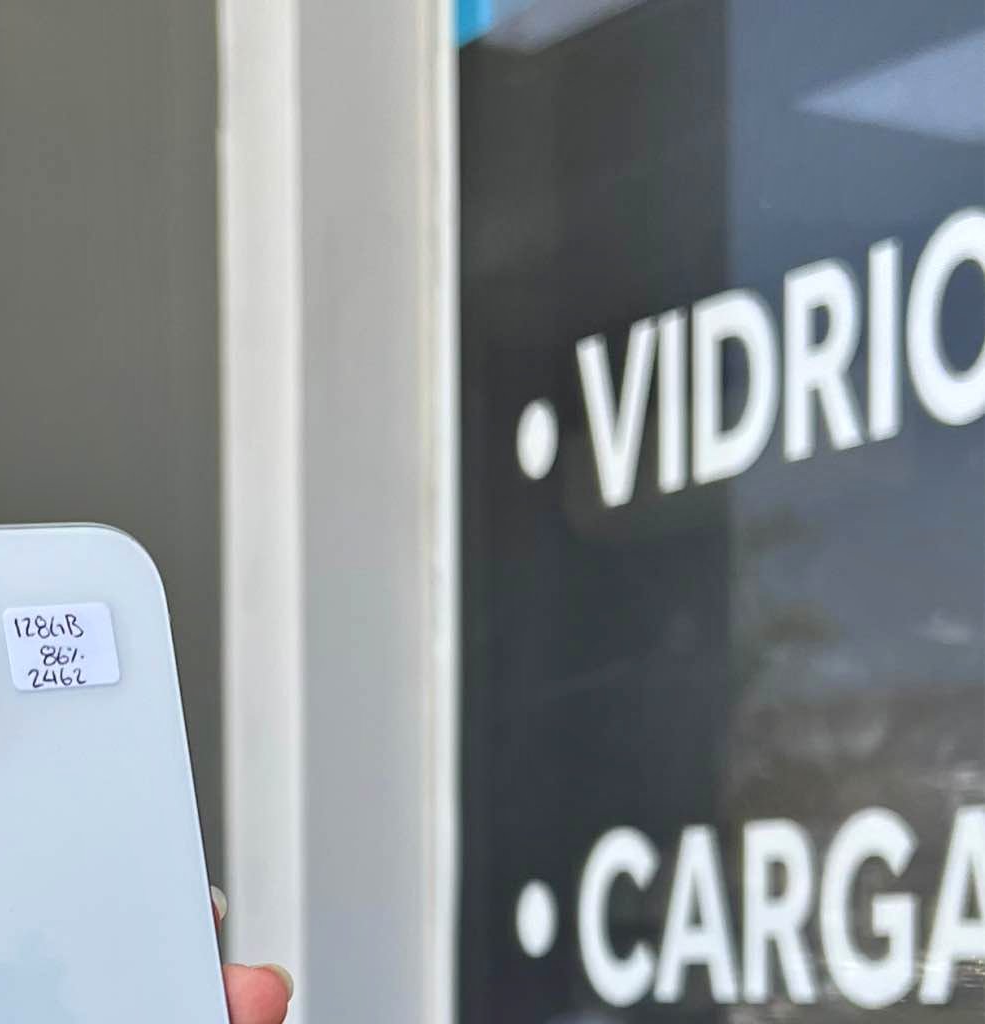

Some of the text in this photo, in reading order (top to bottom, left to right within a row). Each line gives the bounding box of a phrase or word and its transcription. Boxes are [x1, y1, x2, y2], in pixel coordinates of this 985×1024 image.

[576, 206, 985, 508] VIDRIO
[14, 613, 84, 639] 128GB
[28, 667, 87, 688] 2462
[578, 805, 985, 1008] CARGA
